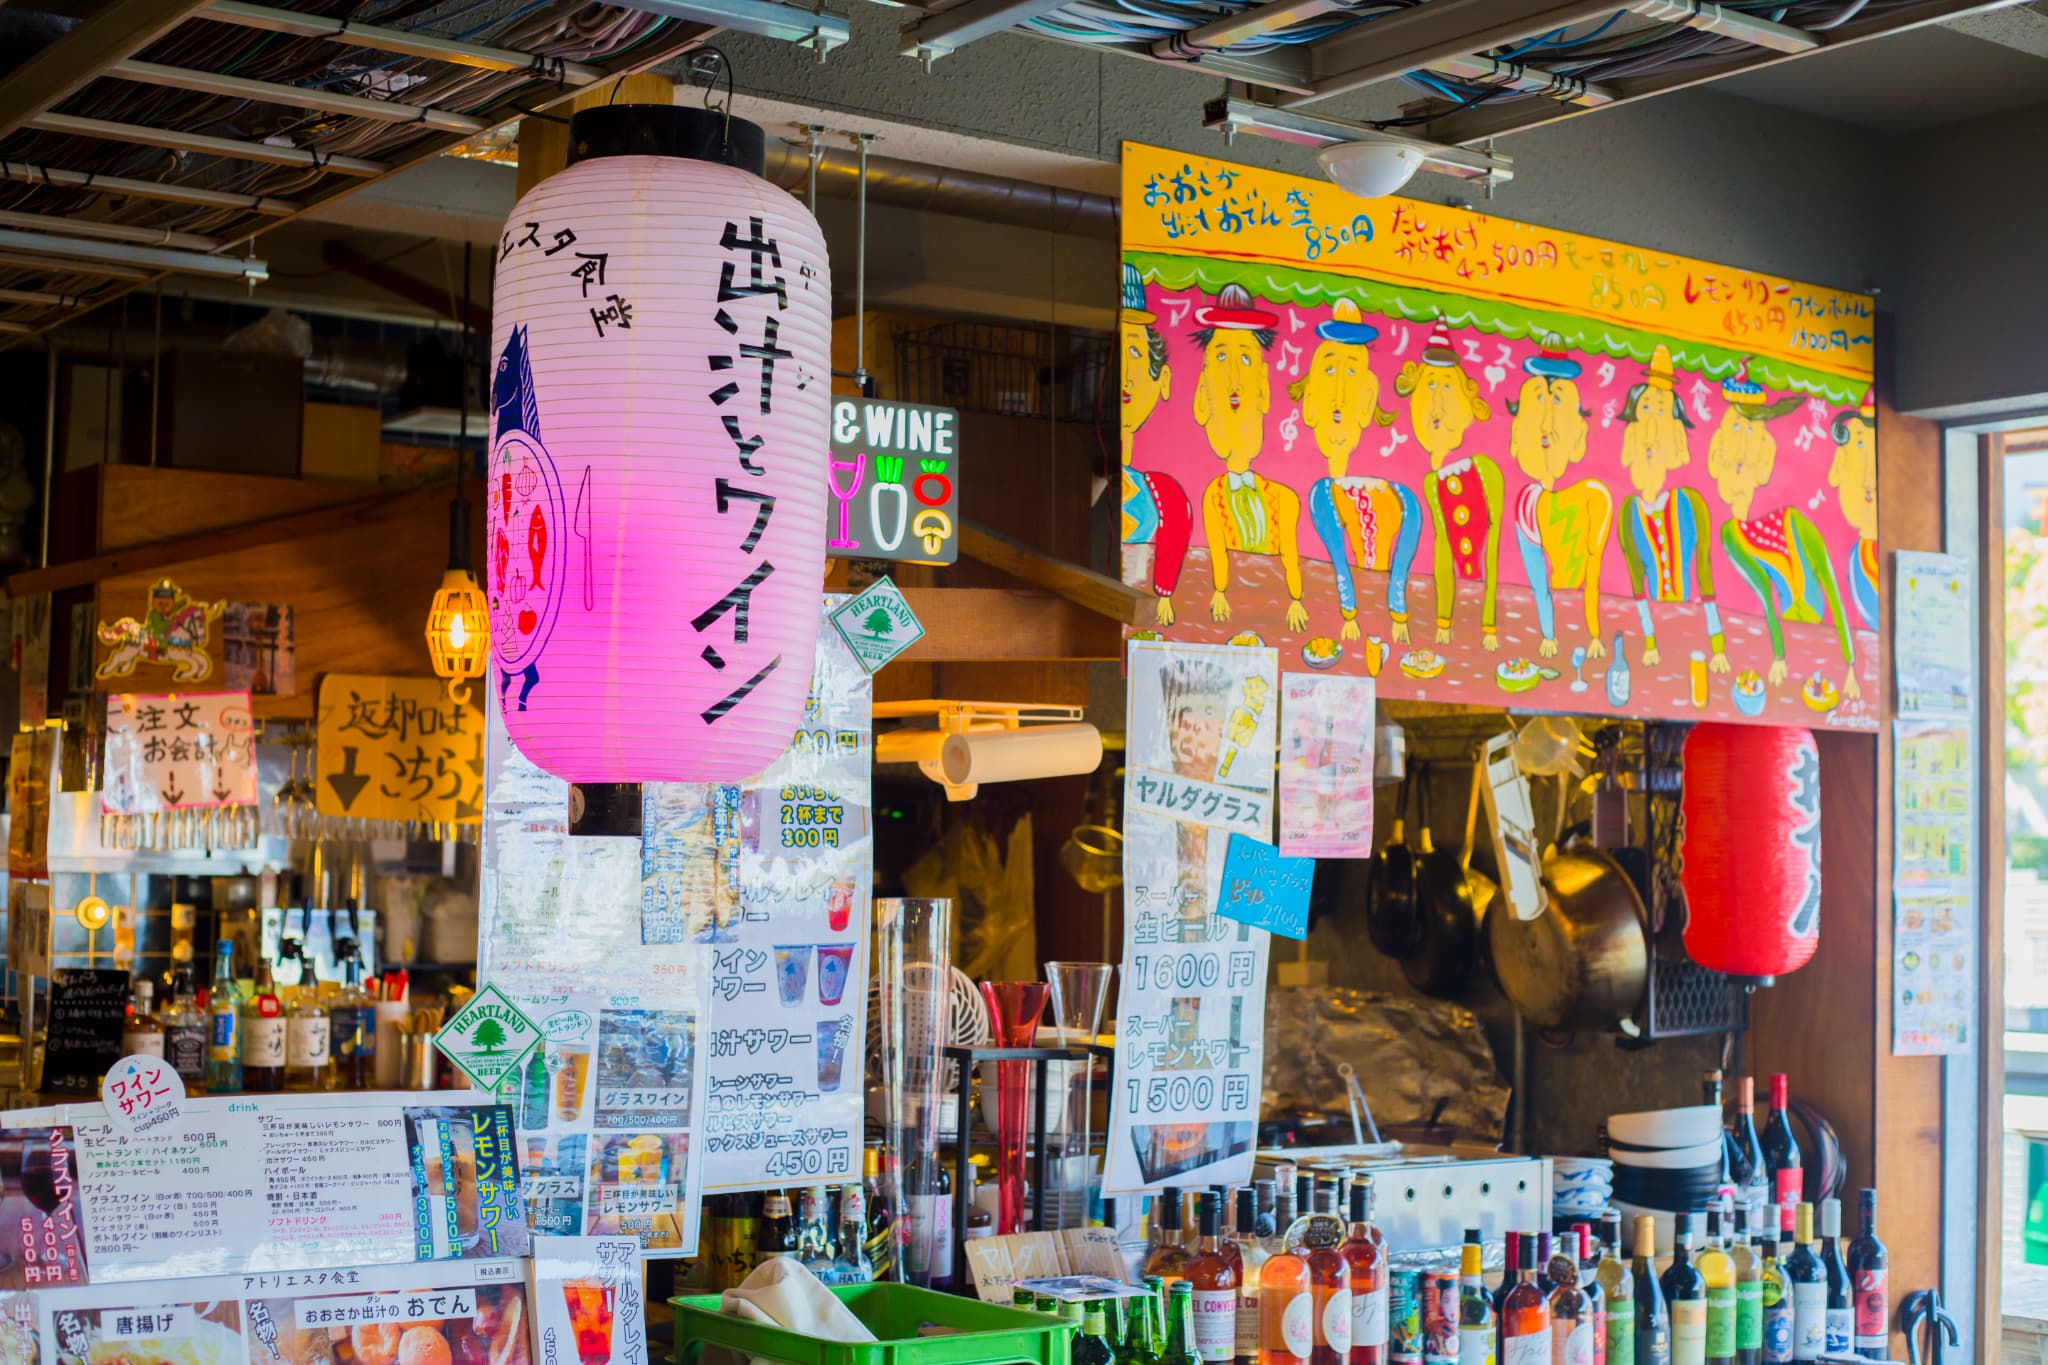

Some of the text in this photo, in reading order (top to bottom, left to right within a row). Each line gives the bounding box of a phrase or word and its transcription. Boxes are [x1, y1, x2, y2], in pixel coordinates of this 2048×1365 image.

[1143, 163, 1240, 209] おおさか
[1304, 213, 1375, 260] 850円
[1492, 240, 1558, 273] 500円
[1589, 272, 1668, 312] 850円
[1722, 304, 1787, 335] 450円
[1788, 295, 1874, 320] ワインボトル
[834, 401, 953, 454] & WINE
[690, 215, 795, 725] 出汁とワイン
[850, 595, 911, 628] HEARTLAND
[862, 650, 884, 660] BEER
[337, 689, 468, 743] 返却口は
[143, 732, 220, 764] お会計
[379, 745, 463, 802] こちら
[1136, 775, 1262, 825] ヤルダグラス
[780, 805, 844, 826] 2杯まで
[781, 828, 840, 848] 300円
[1134, 885, 1201, 906] スーパー
[1133, 911, 1229, 945] 生ビール
[1134, 950, 1256, 991] 1600円
[453, 1004, 526, 1036] HEARTLAND
[1125, 1015, 1192, 1038] スーパー
[1126, 1037, 1250, 1071] レモンサワー
[110, 1068, 162, 1100] ワイン
[477, 1067, 502, 1077] BEER
[118, 1087, 171, 1116] サワー
[228, 1103, 259, 1113] drink
[604, 1091, 685, 1106] グラスワイン
[1127, 1073, 1250, 1114] 1500円
[76, 1124, 114, 1137] ビール
[258, 1115, 283, 1124] サワー
[83, 1135, 129, 1148] 生ビール
[183, 1132, 217, 1143] 500円
[86, 1147, 142, 1160] ハートランド
[151, 1145, 198, 1156] ハイネケン
[704, 1128, 848, 1153] ックスジュースサワー
[263, 1166, 307, 1175] ハイボール
[495, 1110, 520, 1221] 三杯目が美味しい
[765, 1146, 850, 1177] 450円
[50, 1128, 78, 1241] グラスワイン
[81, 1183, 117, 1196] ワイン
[471, 1112, 501, 1253] レモンサワー
[603, 1189, 674, 1200] 三杯目が美味しい
[89, 1193, 151, 1207] グラスワイン
[603, 1200, 674, 1214] レモンサワー
[267, 1216, 328, 1227] ソフトドリンク
[242, 1270, 361, 1290] アトリエスタ食堂
[596, 1242, 618, 1314] サワー
[838, 1271, 868, 1284] HATA
[304, 1294, 471, 1324] おおさか出汁の おでん
[617, 1242, 643, 1365] アールグレイ
[115, 1313, 174, 1336] 唐揚げ
